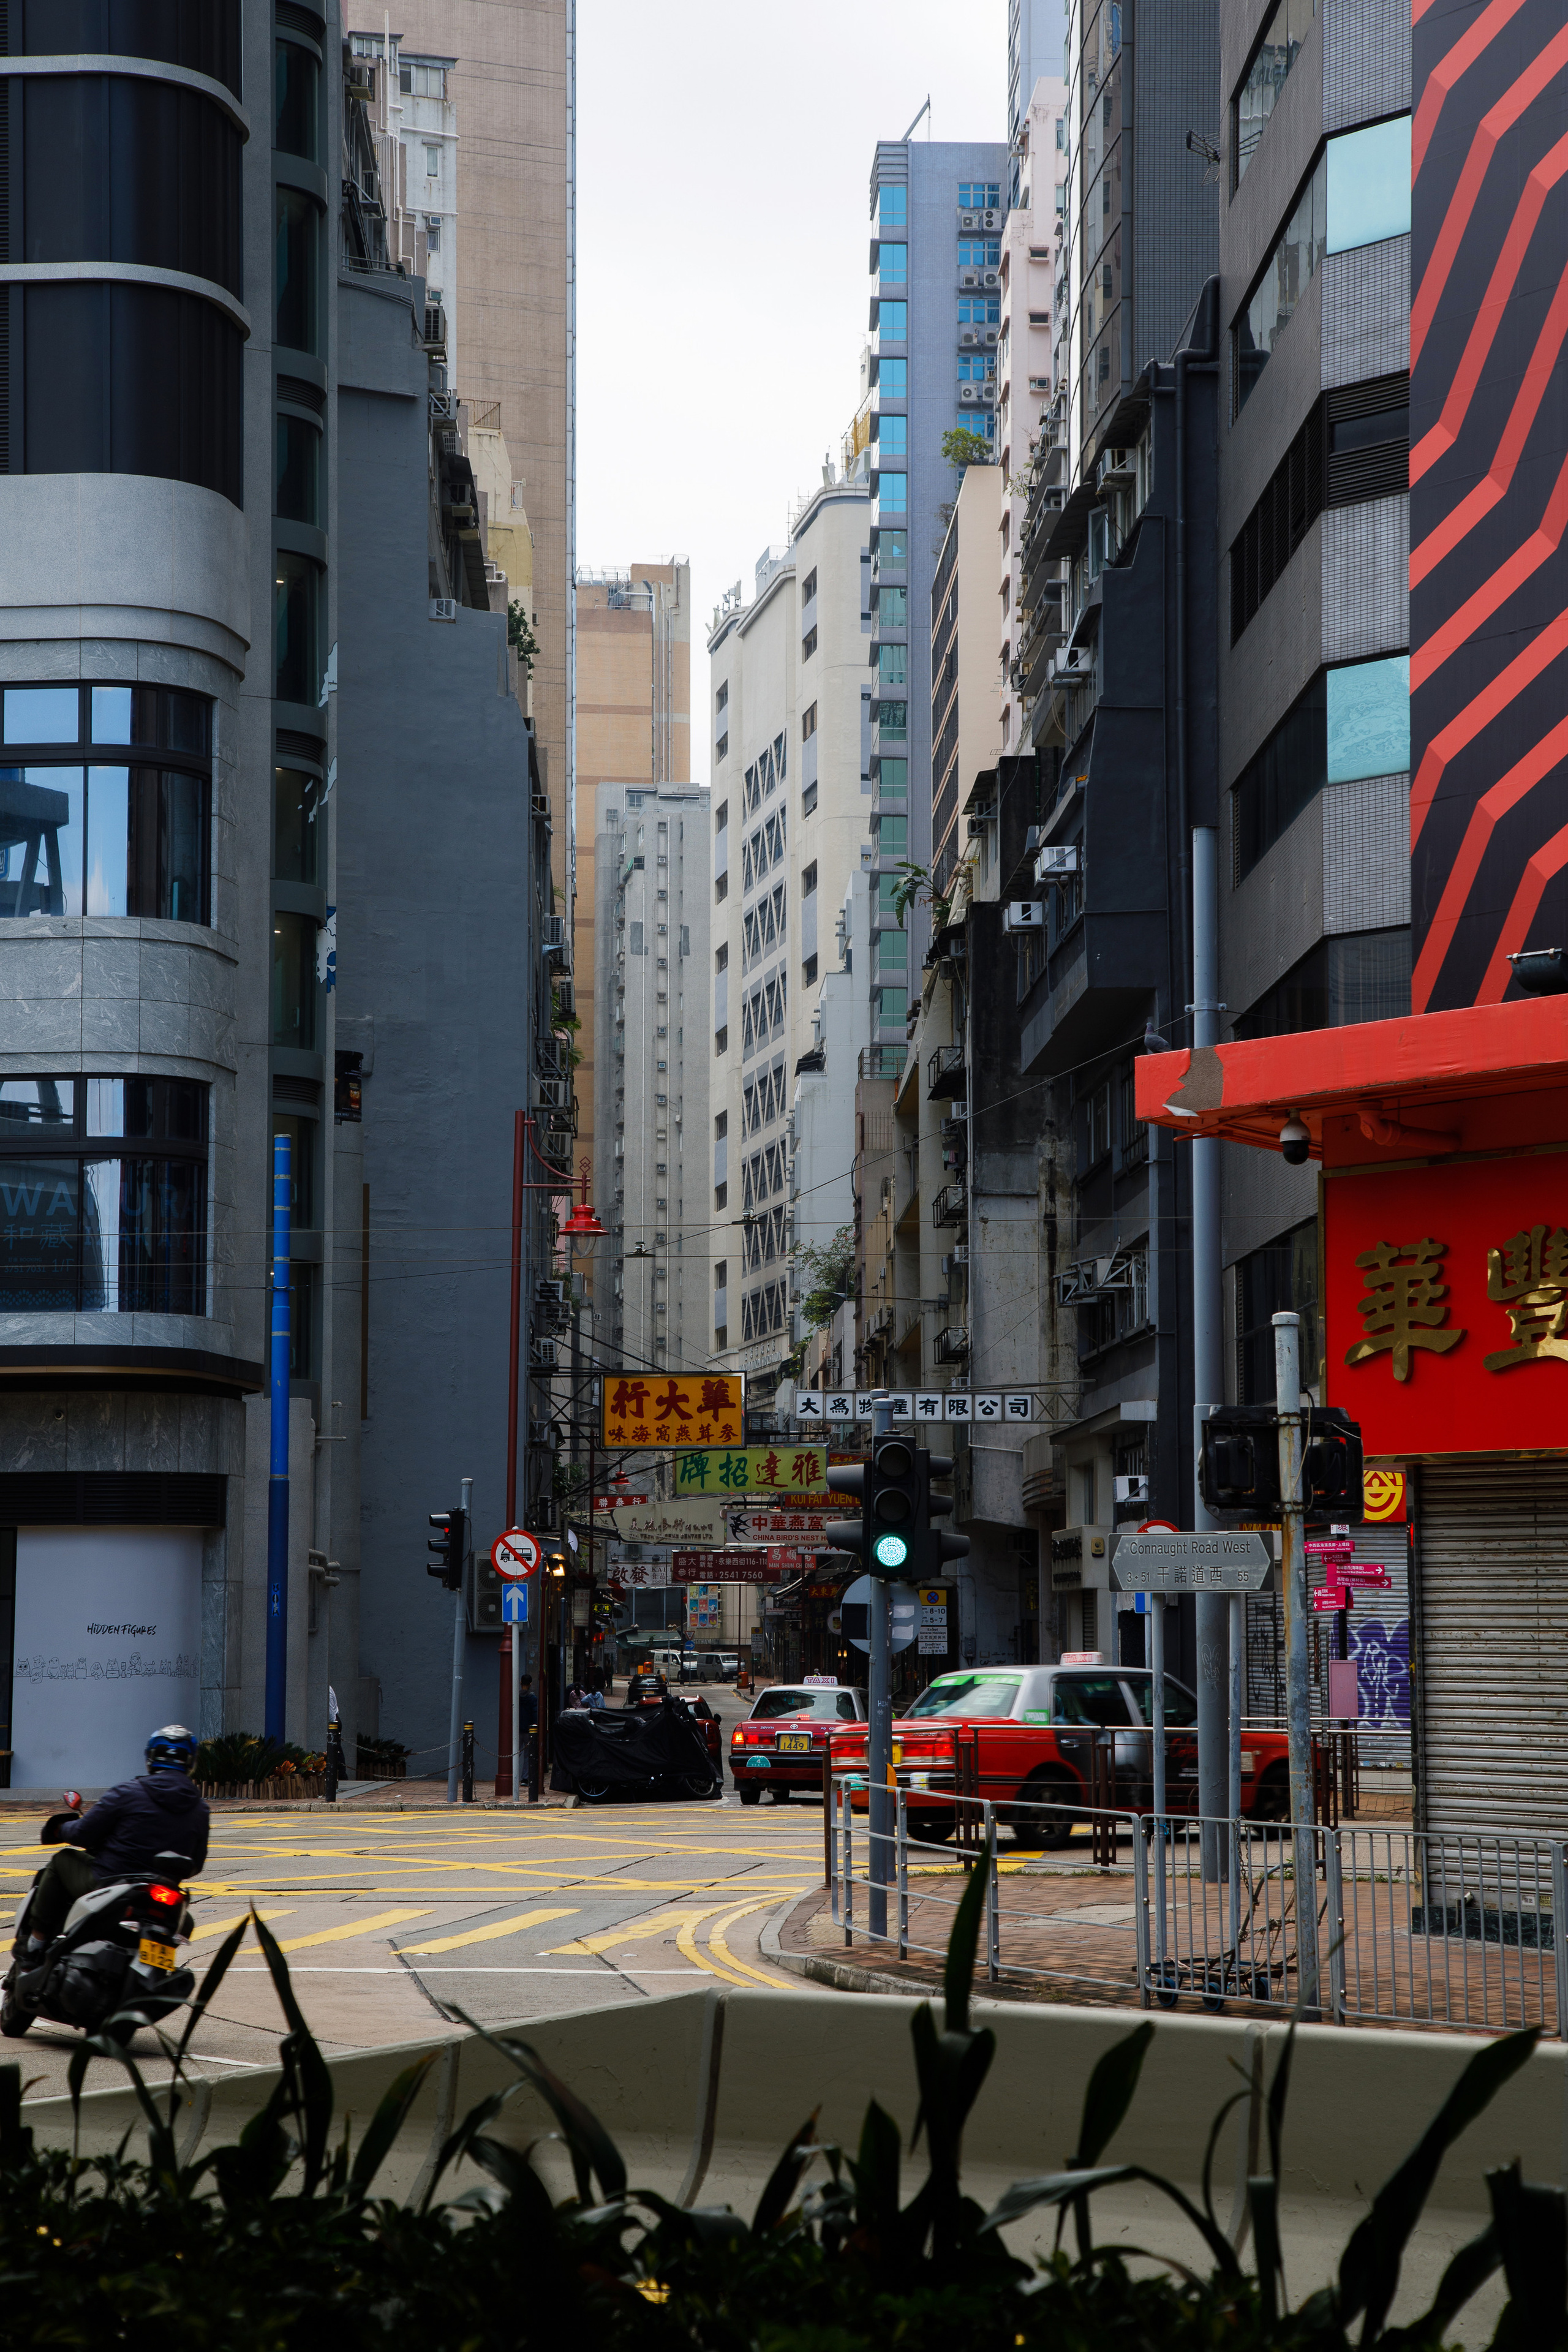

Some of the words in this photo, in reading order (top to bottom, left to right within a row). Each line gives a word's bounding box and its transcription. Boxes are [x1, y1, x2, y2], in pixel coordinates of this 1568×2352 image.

[3, 1223, 73, 1250] 和藏
[598, 1497, 642, 1507] 聯泰行
[791, 1494, 807, 1505] KUI
[809, 1494, 827, 1505] FAT
[829, 1494, 854, 1505] YUEN
[1130, 1540, 1187, 1556] Connaught
[1191, 1540, 1218, 1554] Road
[1223, 1540, 1251, 1554] West
[719, 1570, 739, 1579] 2541
[742, 1570, 763, 1579] 7560
[1126, 1572, 1133, 1582] 3
[1141, 1572, 1150, 1582] 51
[1157, 1566, 1223, 1584] 干諾道西
[1237, 1571, 1249, 1582] 55
[1063, 1653, 1095, 1662] TAXI
